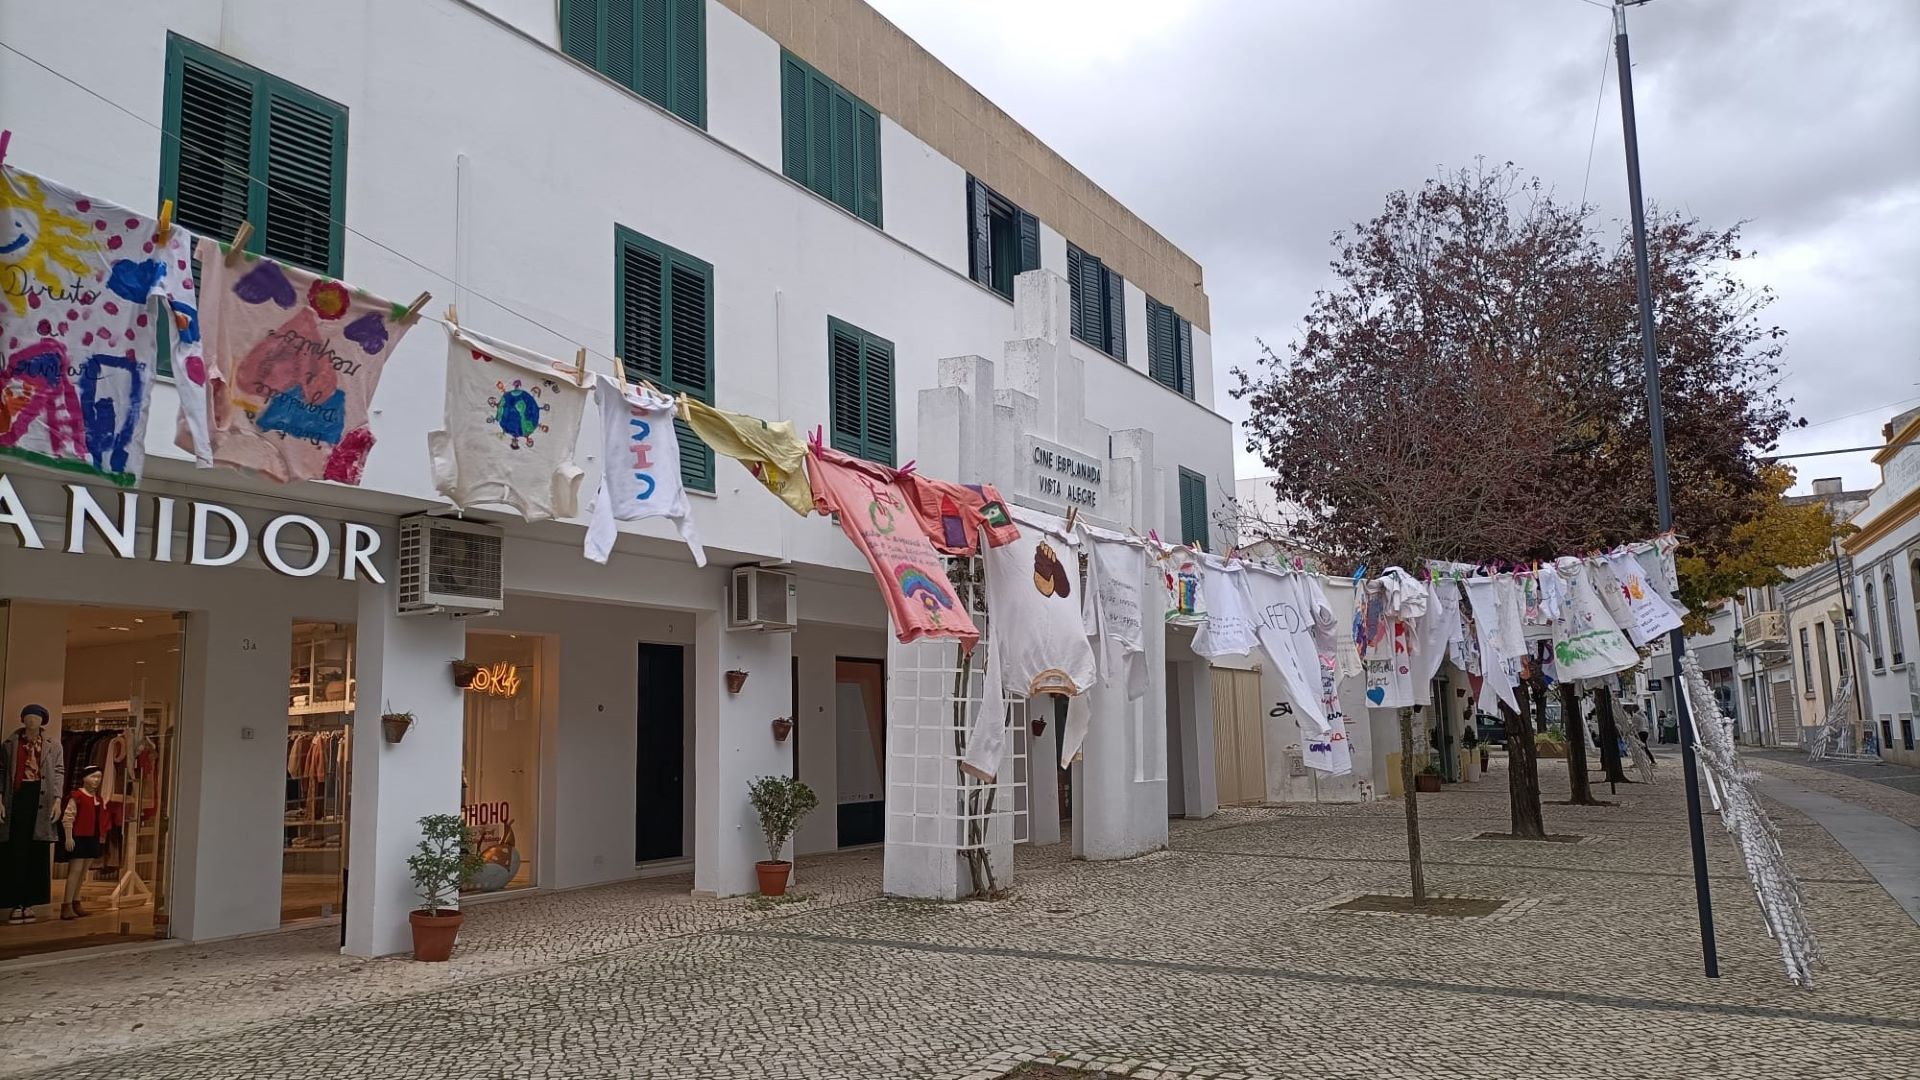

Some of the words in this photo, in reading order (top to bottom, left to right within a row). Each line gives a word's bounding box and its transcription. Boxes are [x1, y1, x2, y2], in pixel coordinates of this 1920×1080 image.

[1033, 447, 1054, 469] CINE
[1056, 455, 1101, 485] ESPLANADA
[1039, 475, 1062, 497] VISTA
[1066, 484, 1097, 508] ALEGRE
